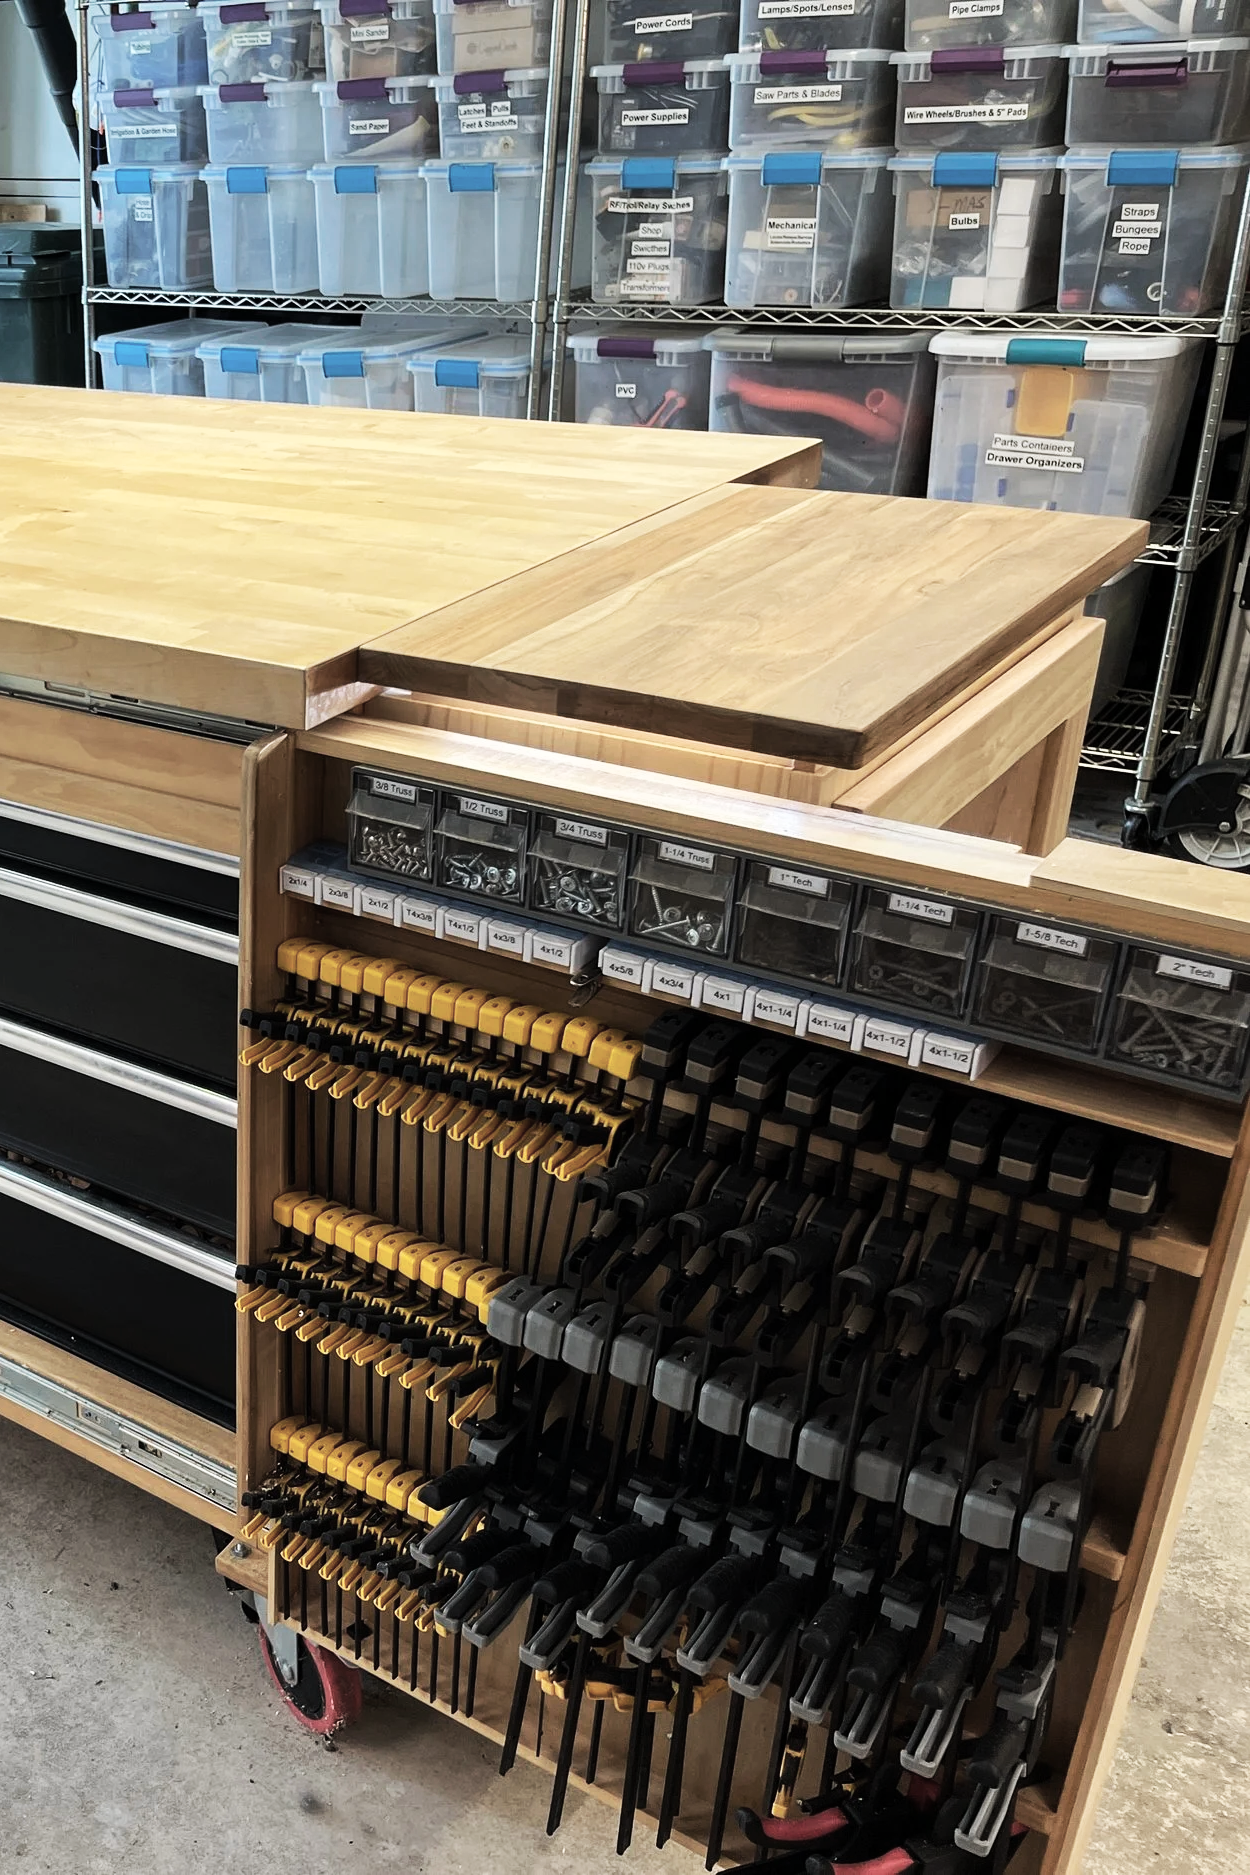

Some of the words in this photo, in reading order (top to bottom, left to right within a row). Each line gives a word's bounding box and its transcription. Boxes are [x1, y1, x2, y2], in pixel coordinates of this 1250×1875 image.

[761, 3, 853, 15] Lamps/Spots/Lenses
[952, 6, 969, 14] Pipe
[971, 4, 1001, 13] Clamps
[636, 20, 663, 30] Power
[665, 17, 691, 27] Cords
[366, 28, 387, 37] Sander
[756, 91, 775, 100] Saw
[777, 89, 799, 99] Parts
[810, 88, 840, 98] Blades
[459, 107, 485, 117] Latches
[493, 104, 509, 112] Pulls
[907, 111, 924, 119] Wire
[925, 109, 986, 119] Wheels/Brushes
[988, 108, 994, 116] &
[1007, 108, 1026, 116] Pads
[623, 113, 649, 122] Power
[651, 112, 687, 122] Supplies
[351, 123, 367, 131] Sand
[369, 122, 388, 131] Paper
[462, 121, 476, 130] Feet
[485, 119, 517, 128] Standoffs
[1124, 207, 1155, 217] Straps
[768, 221, 816, 230] Mechanical
[951, 217, 978, 226] Bulbs
[642, 226, 662, 235] Shop
[1115, 225, 1159, 235] Bungees
[1122, 242, 1148, 251] Rope
[647, 262, 669, 272] Plugs
[618, 386, 634, 394] PVC
[993, 436, 1018, 448] Parts
[1021, 440, 1073, 454] Containers
[987, 453, 1023, 464] Drawer
[1025, 456, 1082, 469] Organizers
[375, 780, 389, 792] 3/8
[390, 784, 414, 797] Truss
[464, 800, 478, 812] 1/2
[480, 804, 504, 818] Truss
[560, 822, 575, 833] 3/4
[578, 826, 603, 840] Truss
[664, 846, 685, 858] 1-1/4
[687, 852, 711, 865] Truss
[288, 877, 308, 887] 2x1/4
[792, 876, 813, 888] Tech
[328, 888, 349, 899] 2x3/8
[368, 898, 389, 909] 2x1/2
[896, 899, 920, 911] 1-1/4
[923, 904, 946, 918] Tech
[493, 933, 516, 944] 4x3/8
[1024, 927, 1051, 942] 1-5/8
[1054, 935, 1079, 949] Tech
[540, 945, 563, 957] 4x1/2
[609, 963, 634, 976] 4x5/8
[1189, 965, 1215, 979] Tech
[659, 977, 684, 989] 4x3/4
[713, 991, 730, 1001] 4x1
[756, 1002, 792, 1018] 4x1-1/4
[811, 1017, 846, 1032] 4x1-1/4
[866, 1031, 906, 1047] 4x1-1/2
[929, 1046, 968, 1063] 4x1-1/2
